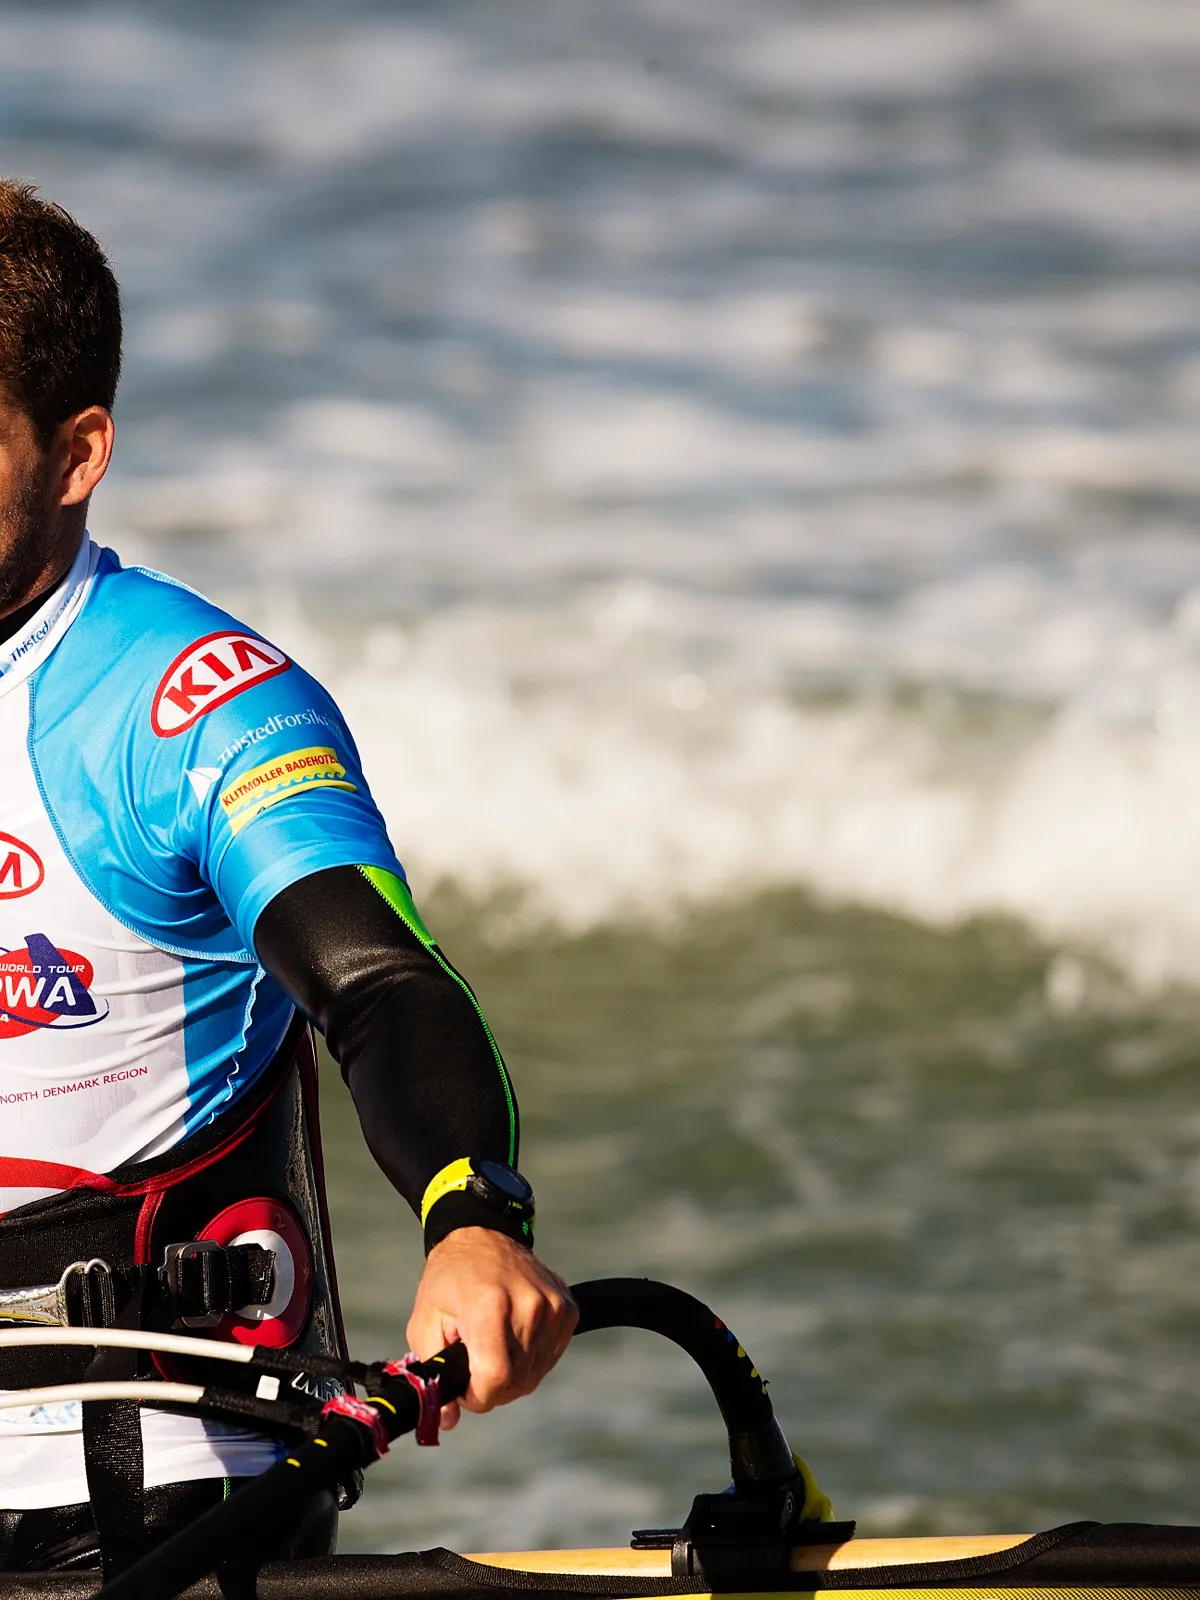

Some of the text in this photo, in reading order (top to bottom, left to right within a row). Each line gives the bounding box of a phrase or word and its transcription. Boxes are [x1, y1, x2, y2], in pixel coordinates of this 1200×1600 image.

[164, 640, 279, 715] KIA
[222, 767, 285, 807] KLITMØLLER
[48, 964, 85, 974] TOUR
[0, 1066, 148, 1105] NORTH DENMARK REGION
